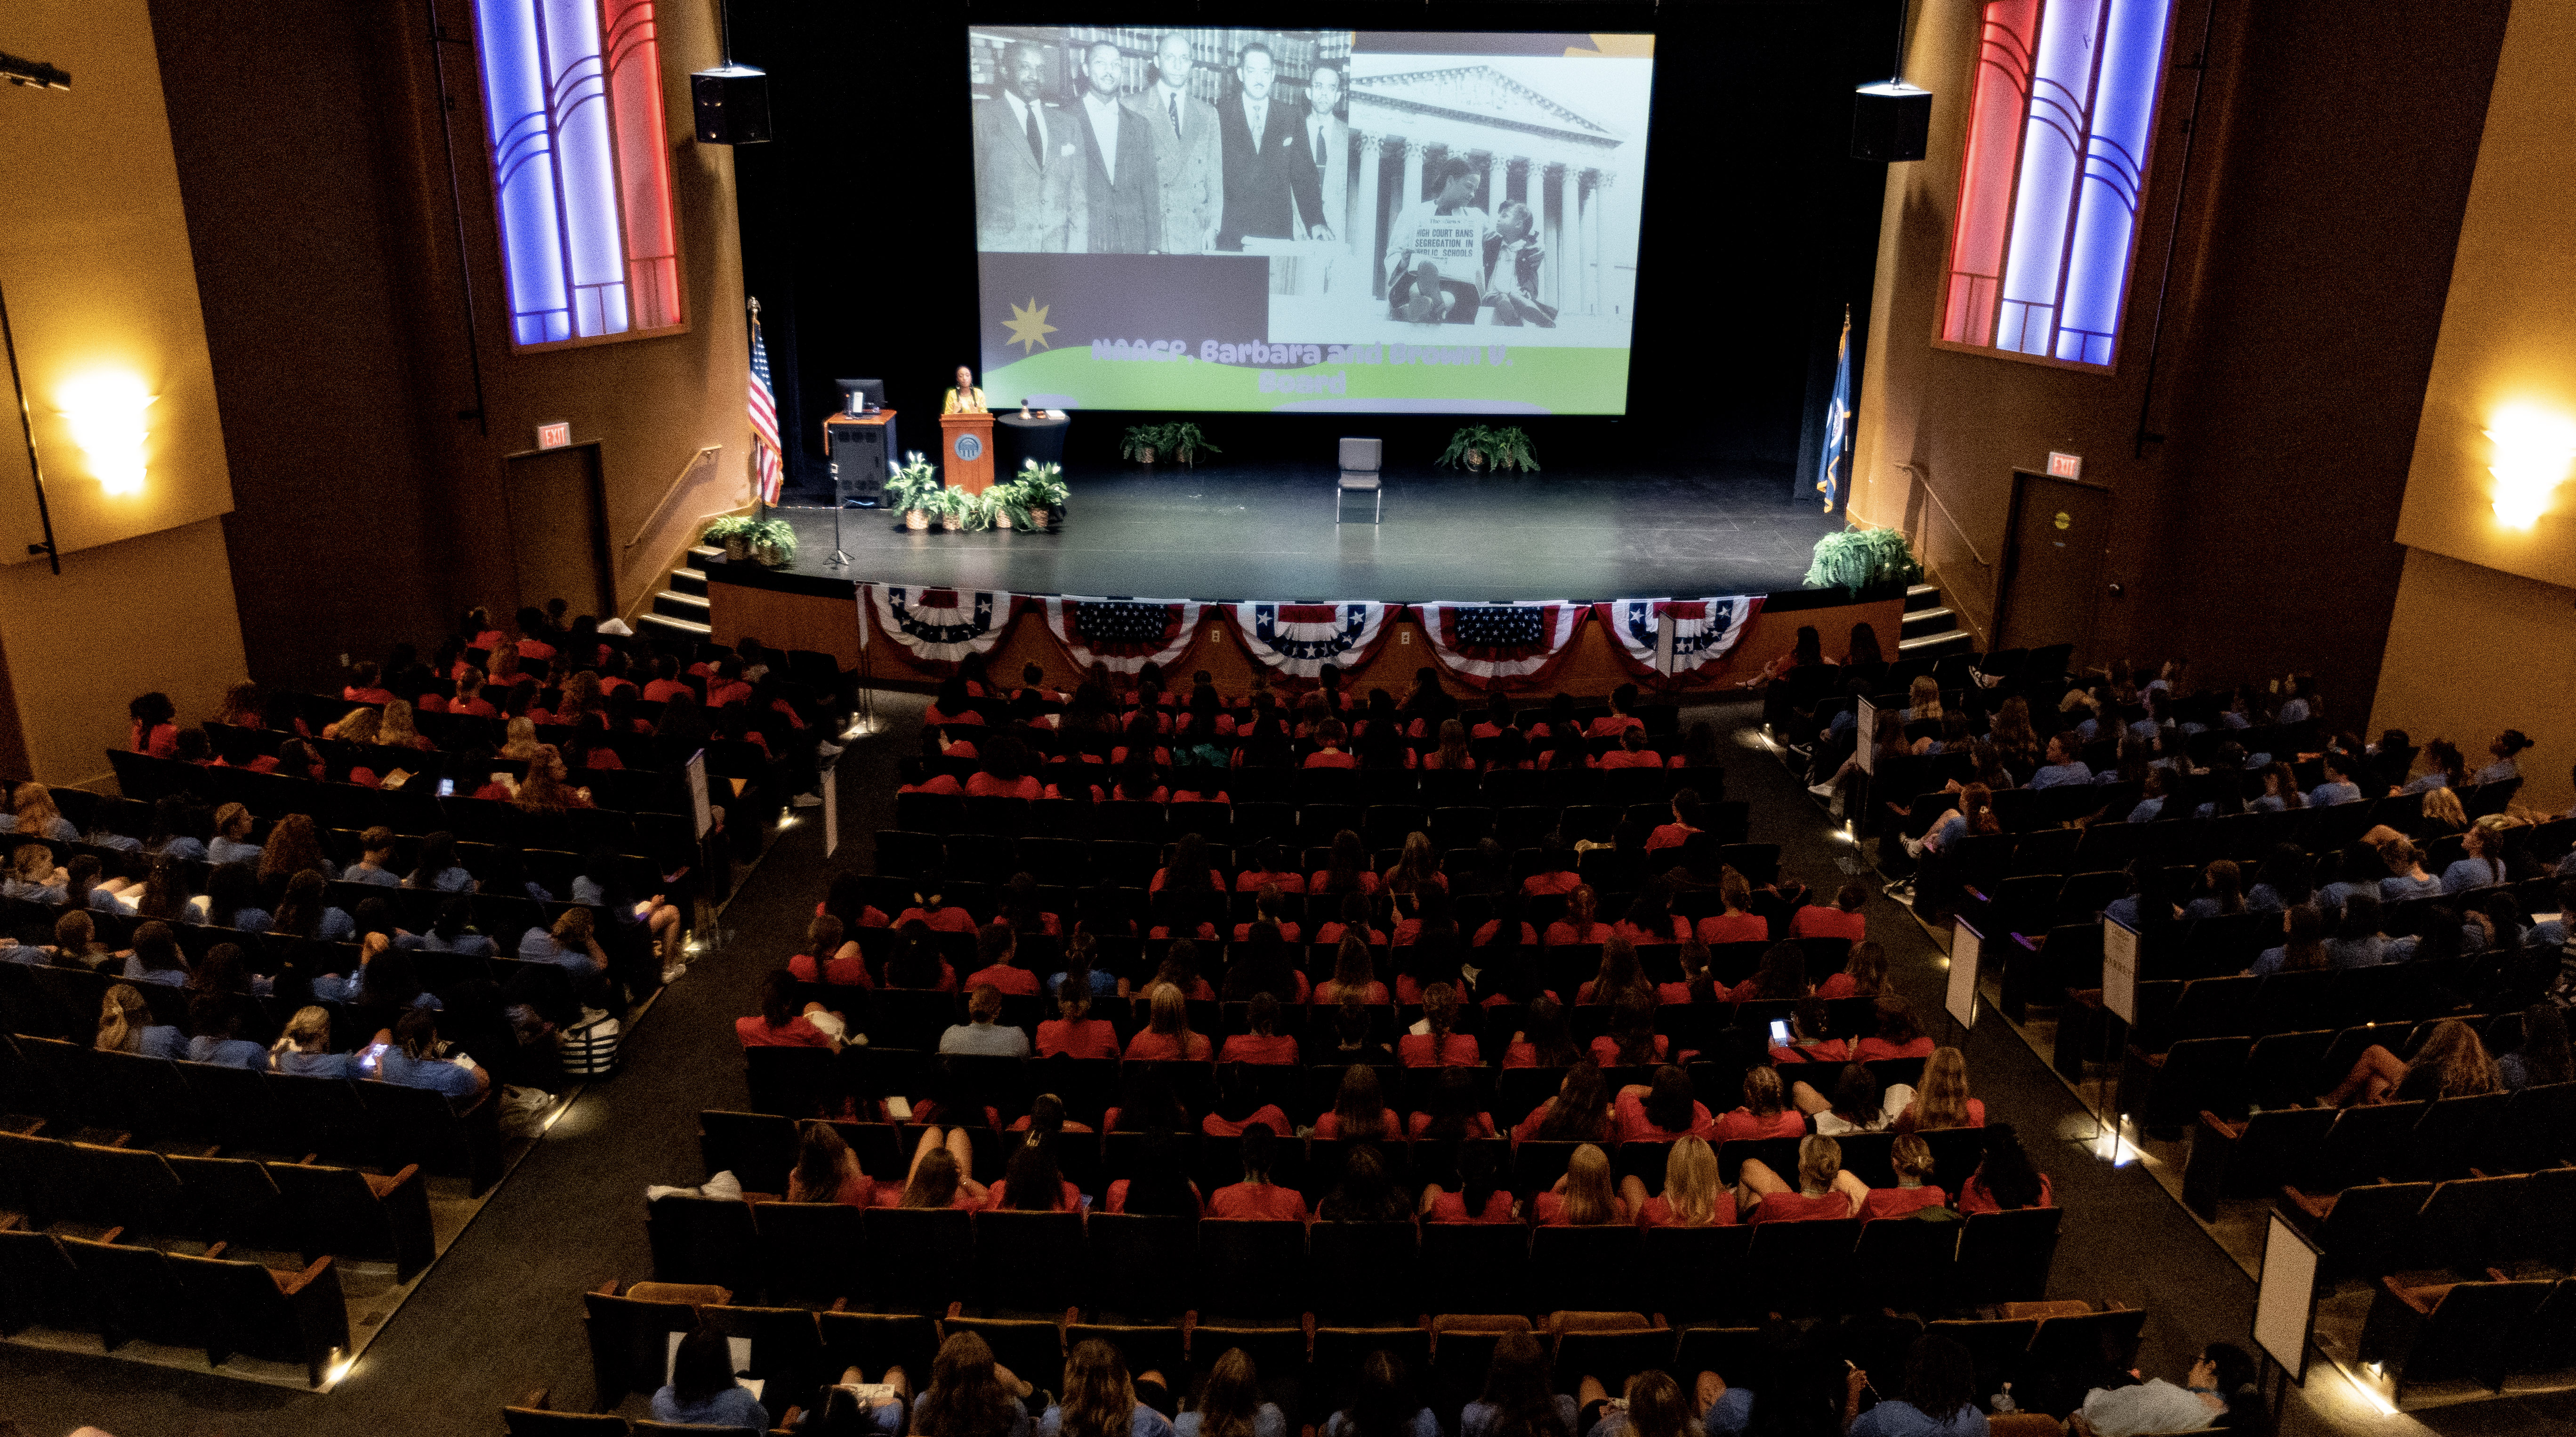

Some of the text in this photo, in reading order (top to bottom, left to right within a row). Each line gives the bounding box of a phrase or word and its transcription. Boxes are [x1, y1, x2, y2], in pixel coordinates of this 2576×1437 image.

[1416, 229, 1474, 237] HIGH COURT BANS
[1415, 239, 1473, 247] SEGREGATION IN
[1092, 339, 1513, 366] NAACP, Barbara and Brown V.
[1259, 370, 1346, 394] Board
[545, 427, 565, 445] EXIT
[2054, 457, 2075, 476] EXIT
